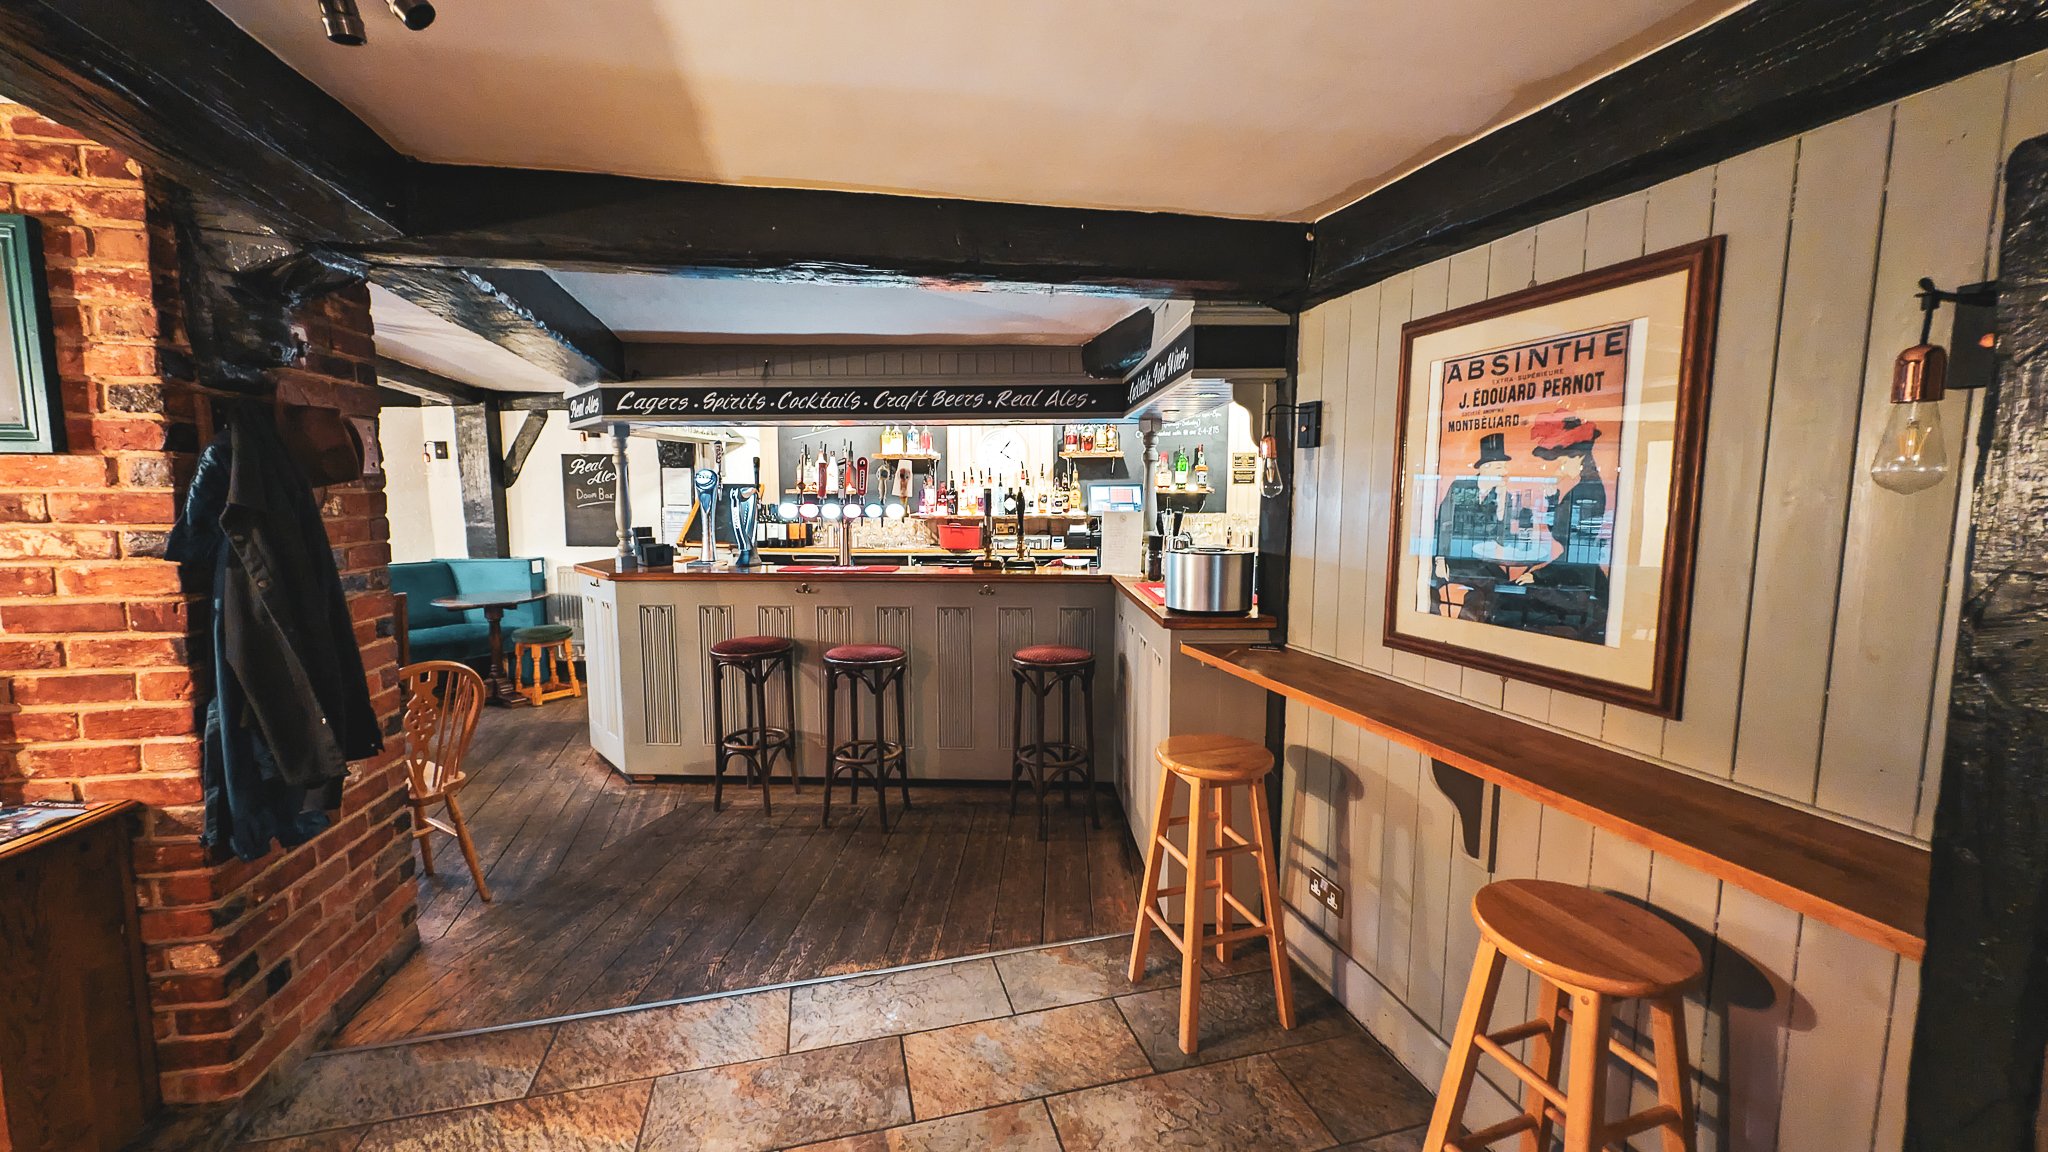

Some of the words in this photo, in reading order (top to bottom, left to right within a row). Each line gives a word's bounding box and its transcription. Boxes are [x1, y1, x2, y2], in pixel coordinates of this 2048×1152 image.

[1447, 331, 1625, 384] ABSINTHE
[1153, 361, 1167, 388] Fine
[1458, 393, 1470, 409] J.
[1472, 382, 1537, 407] ÉDOUARD
[1542, 371, 1605, 398] PERNOT
[570, 398, 586, 418] Real
[585, 395, 600, 414] Ales
[616, 390, 689, 415] Lagers
[703, 391, 766, 412] Spirits
[777, 390, 861, 410] Cocktails
[873, 390, 929, 411] Craft
[931, 389, 985, 408] Beers
[994, 389, 1044, 408] Real
[1044, 389, 1089, 408] Ales
[1448, 414, 1520, 433] MONTBÉLIARD
[568, 456, 608, 475] Real
[587, 470, 617, 485] Ales
[576, 488, 597, 500] Doom
[598, 488, 614, 500] Bar
